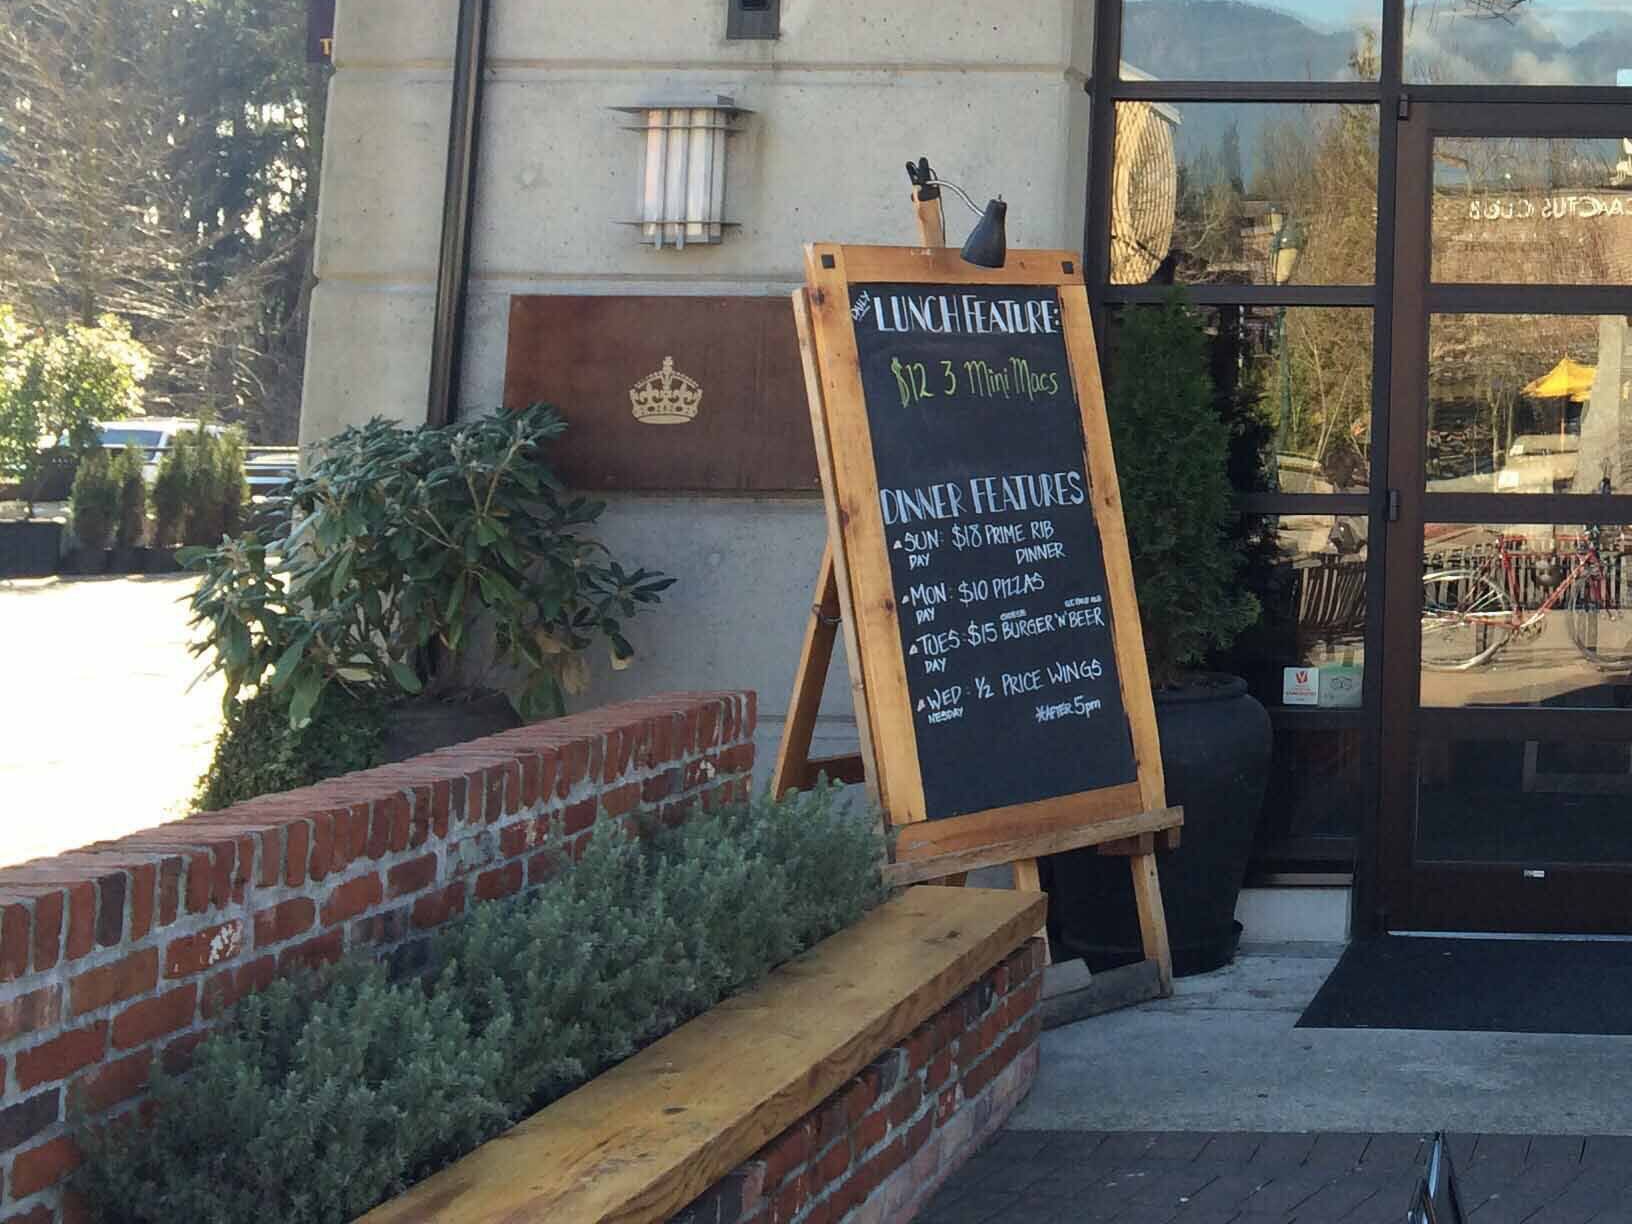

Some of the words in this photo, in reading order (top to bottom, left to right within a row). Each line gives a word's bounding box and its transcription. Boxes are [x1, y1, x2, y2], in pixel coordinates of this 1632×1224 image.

[873, 295, 961, 333] LUNCH
[962, 294, 1060, 334] FEATURE:
[891, 356, 935, 408] $12
[940, 360, 957, 395] 3
[963, 359, 1010, 399] Mini
[1009, 357, 1059, 401] Macs
[880, 481, 967, 525] DINNER
[969, 471, 1085, 514] FEATURES
[952, 523, 983, 551] $18
[986, 523, 1026, 545] PRIME
[1031, 521, 1055, 540] RIB
[909, 554, 930, 570] DAY
[1016, 543, 1066, 565] DINNER
[958, 579, 989, 607] $10
[992, 572, 1045, 600] PIZZAS
[916, 608, 935, 624] DAY
[967, 620, 998, 648] $15
[1001, 615, 1056, 641] BURGER
[1068, 607, 1105, 629] BEER
[925, 657, 946, 674] DAY
[1001, 669, 1043, 697] PRICE
[1047, 658, 1103, 685] WINGS
[928, 707, 964, 724] NESDAY
